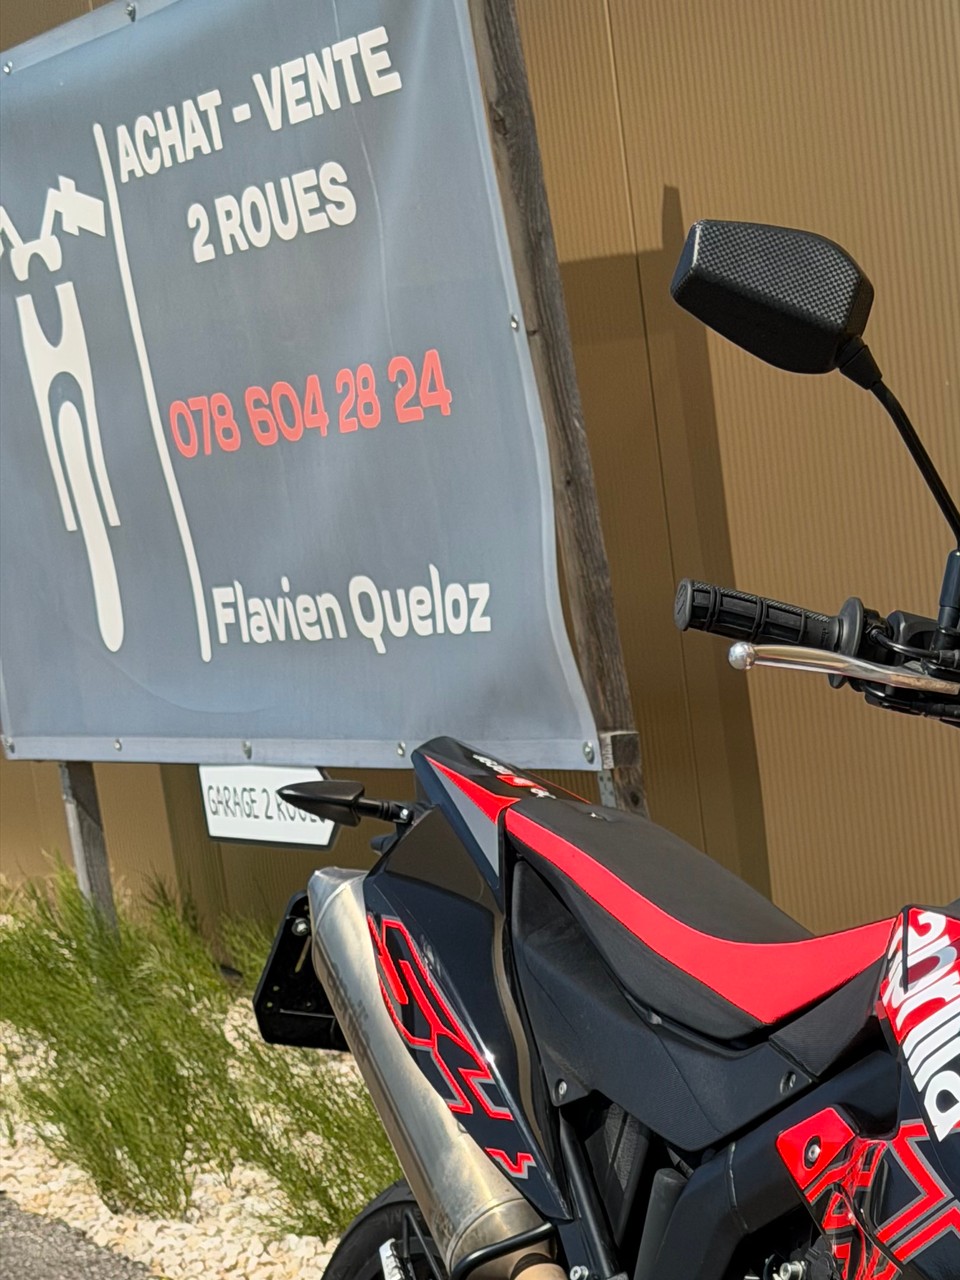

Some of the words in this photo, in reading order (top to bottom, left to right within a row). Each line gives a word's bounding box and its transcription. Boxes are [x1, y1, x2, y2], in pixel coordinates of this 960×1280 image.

[117, 89, 224, 183] ACHAT
[252, 25, 402, 131] VENTE
[187, 202, 216, 263] 2
[217, 161, 357, 256] ROUES
[169, 392, 241, 458] 078
[244, 374, 330, 446] 604
[335, 363, 381, 433] 28
[387, 348, 453, 423] 24
[211, 575, 348, 644] Flavien
[348, 564, 491, 654] Queloz
[207, 785, 259, 819] GARAGE
[261, 788, 274, 820] 2
